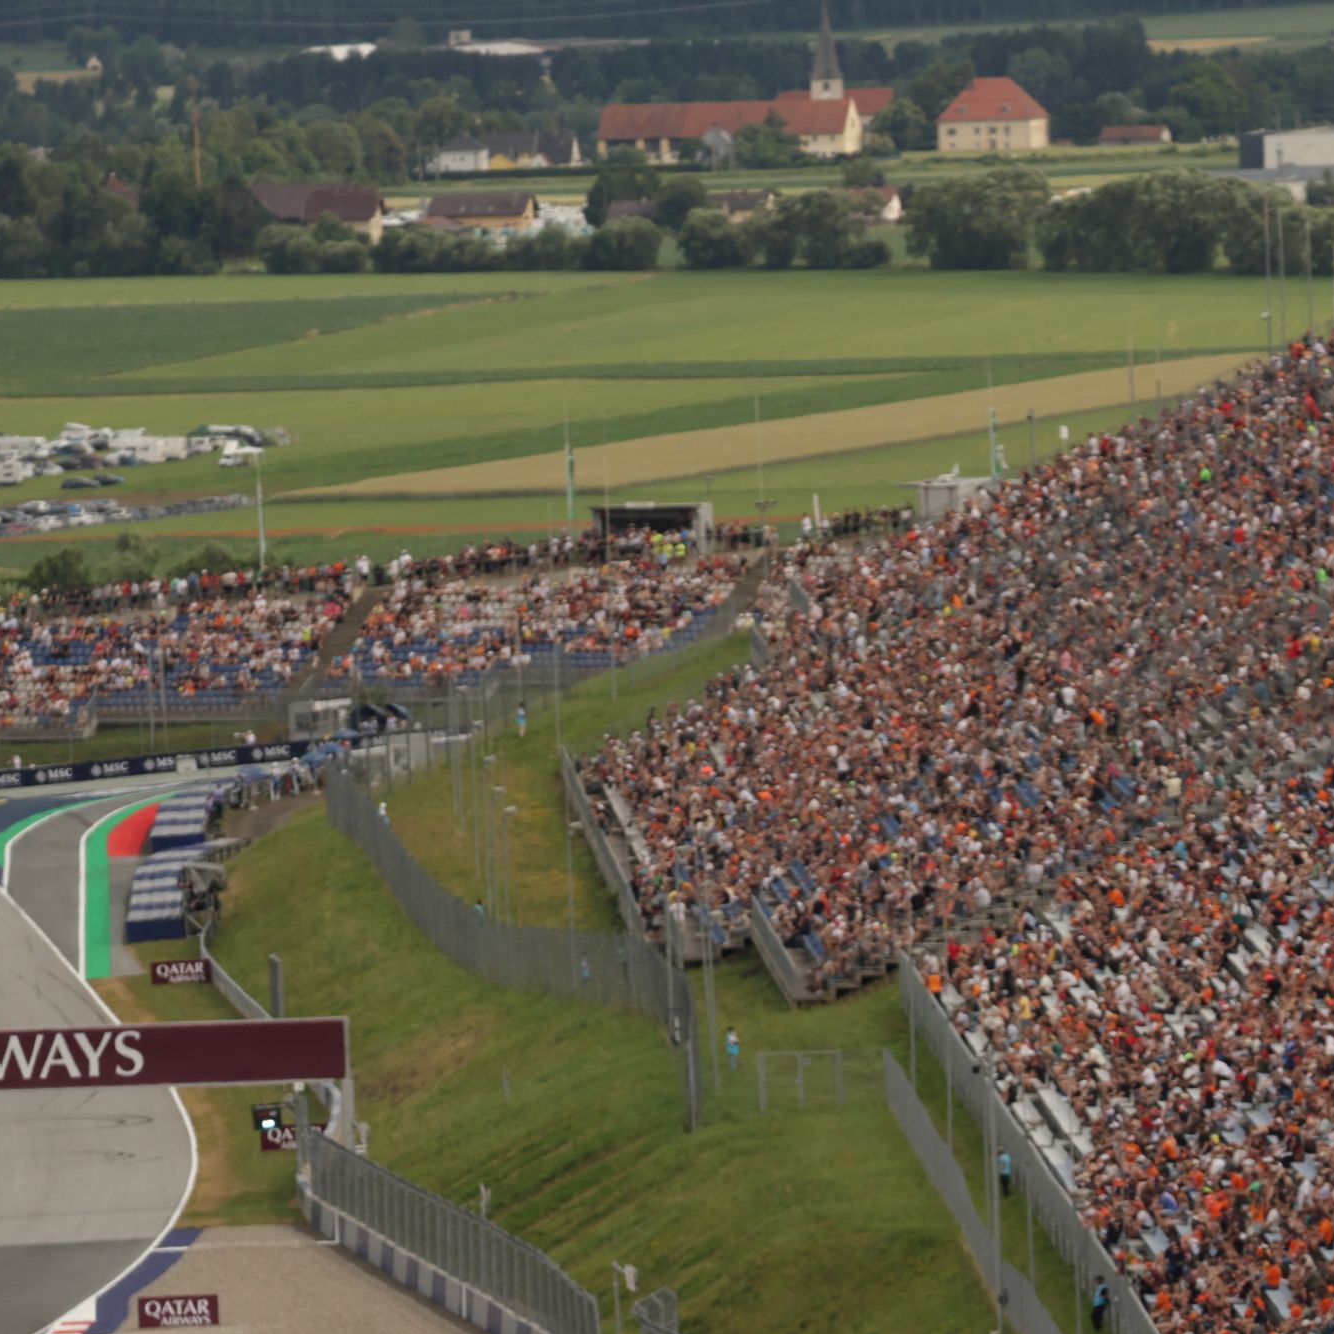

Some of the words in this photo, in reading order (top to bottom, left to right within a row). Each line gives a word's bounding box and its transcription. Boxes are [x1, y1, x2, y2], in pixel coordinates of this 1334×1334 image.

[265, 745, 290, 756] MSC
[103, 761, 128, 772] MSC
[157, 757, 174, 767] MS
[48, 767, 72, 778] MSC
[156, 961, 204, 977] QATAR
[144, 1298, 209, 1319] QATAR
